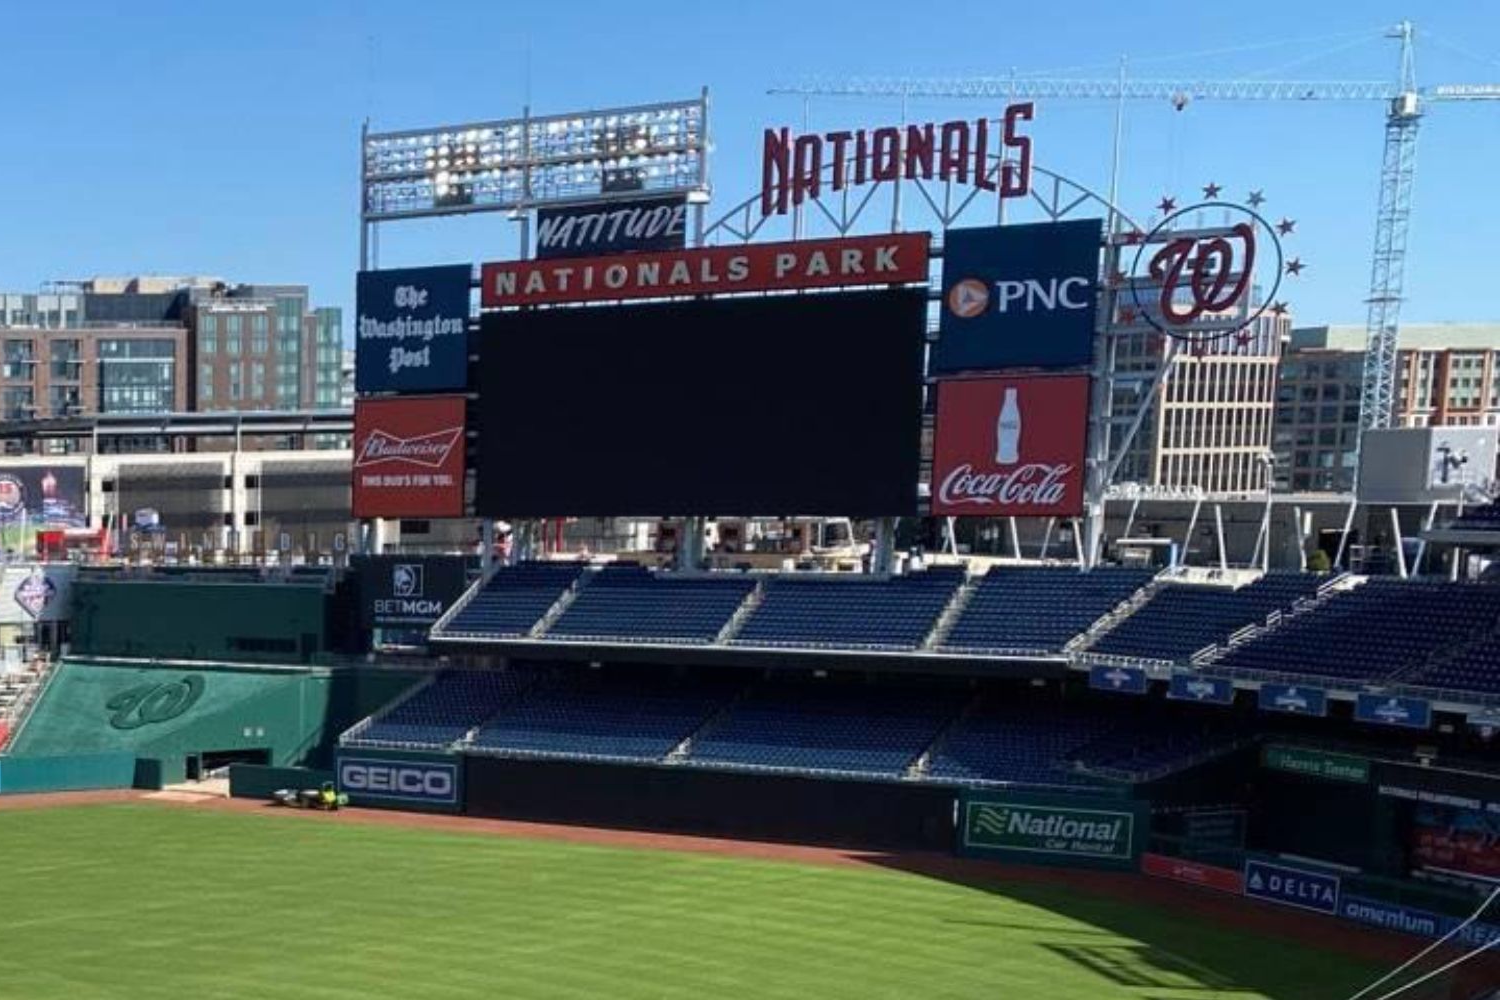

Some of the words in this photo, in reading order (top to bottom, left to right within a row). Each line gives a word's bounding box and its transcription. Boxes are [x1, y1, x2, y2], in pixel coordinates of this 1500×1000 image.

[762, 102, 1035, 216] NATIONALS
[537, 205, 686, 248] NATITUDE
[495, 250, 749, 297] NATIONALS
[776, 245, 899, 279] PARK
[394, 285, 429, 309] The
[996, 276, 1089, 313] PNC
[359, 314, 464, 341] Washington
[389, 345, 431, 374] Post
[366, 437, 450, 457] Budweiser
[374, 599, 443, 615] BETMGM
[342, 765, 451, 795] GEICO
[1008, 811, 1122, 841] National
[1268, 876, 1336, 904] DELTA
[1346, 901, 1436, 935] amentum
